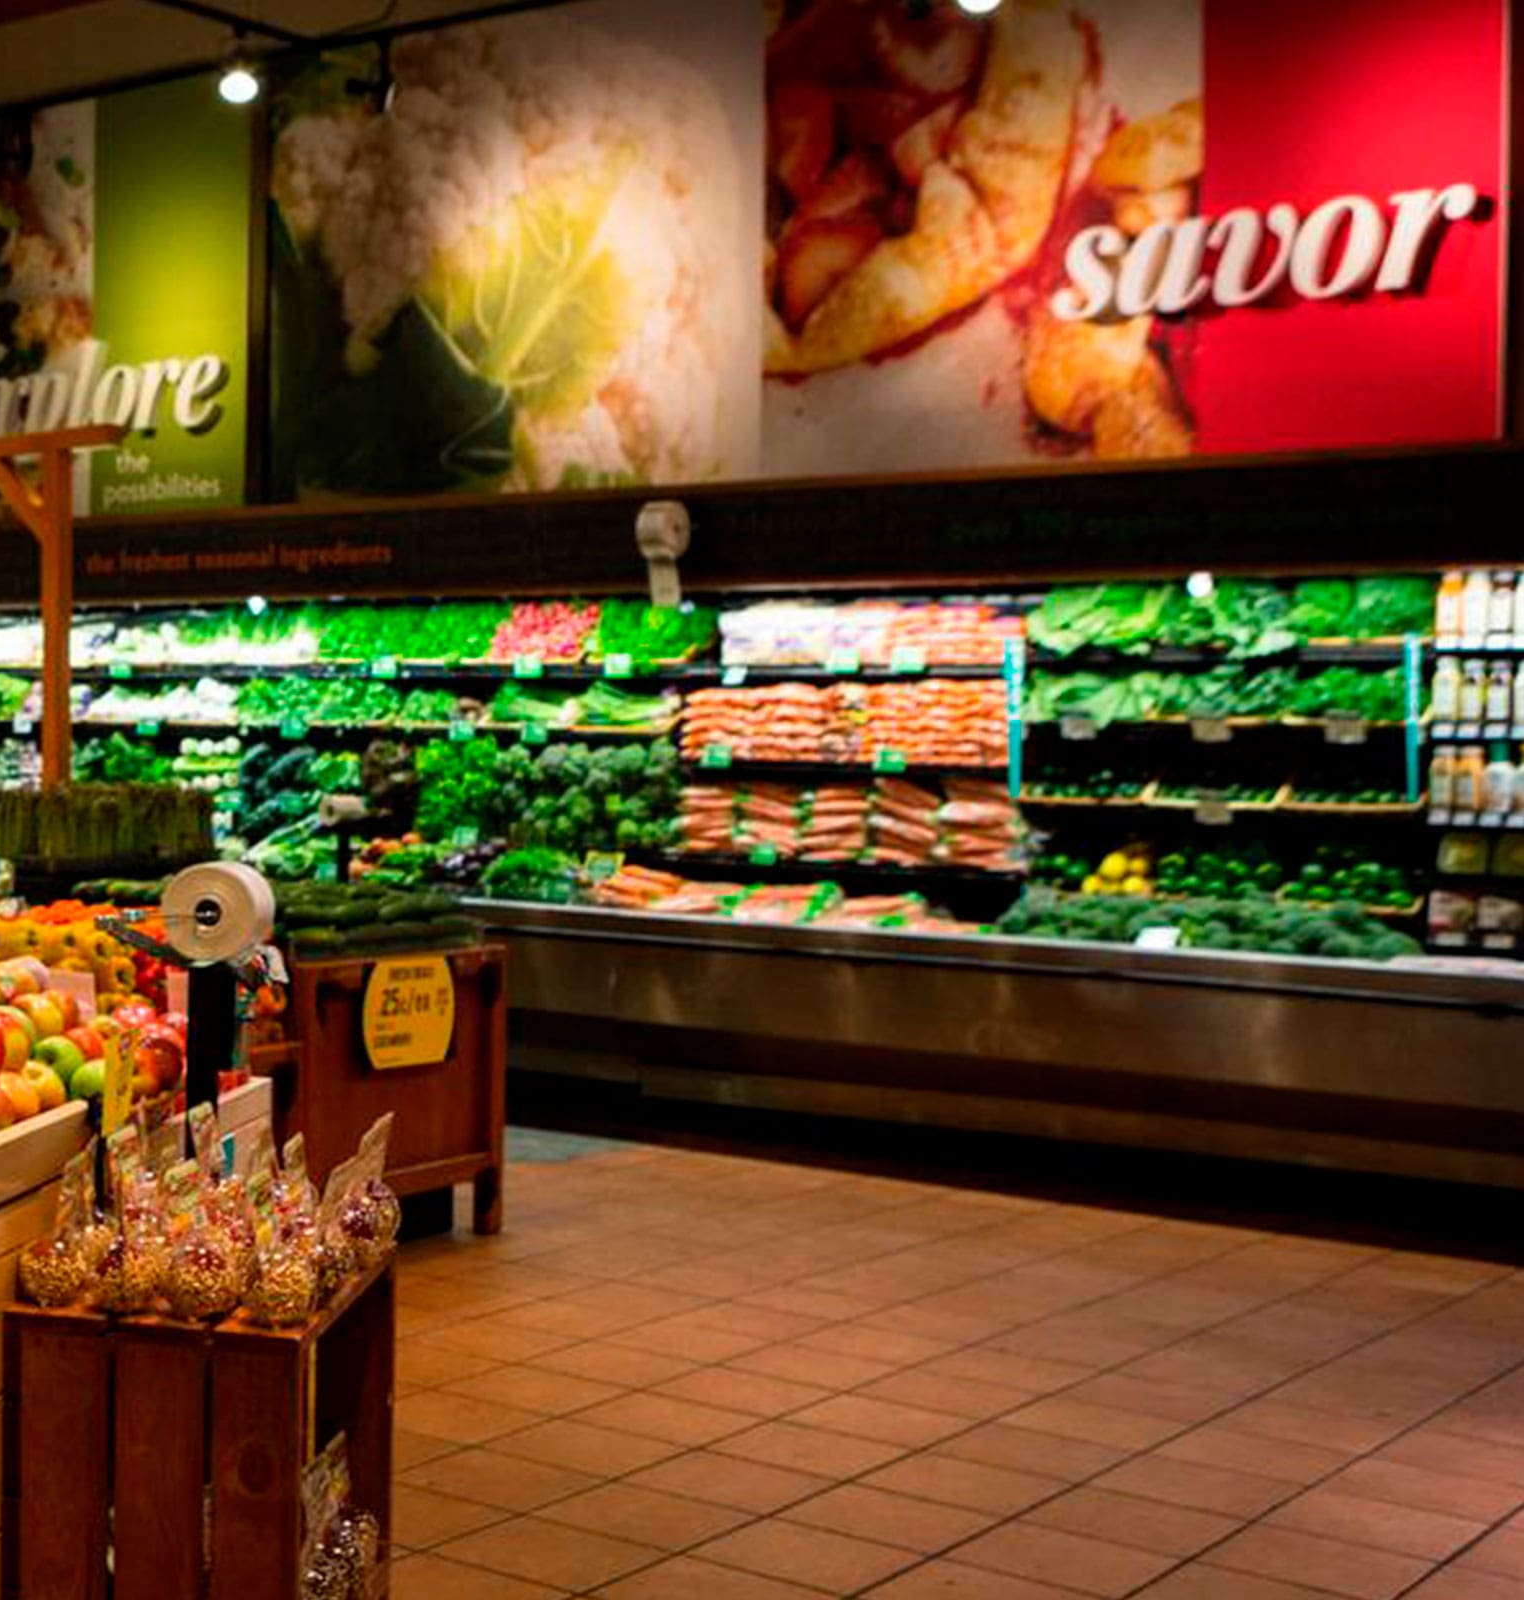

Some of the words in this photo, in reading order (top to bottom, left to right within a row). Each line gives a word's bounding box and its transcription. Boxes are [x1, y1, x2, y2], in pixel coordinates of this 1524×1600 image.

[1051, 183, 1477, 323] savor
[115, 449, 151, 474] the
[102, 473, 222, 508] possibilities
[85, 552, 115, 576] the
[119, 546, 190, 574] freshest
[194, 542, 276, 571] seasonal
[279, 540, 393, 573] ingredients
